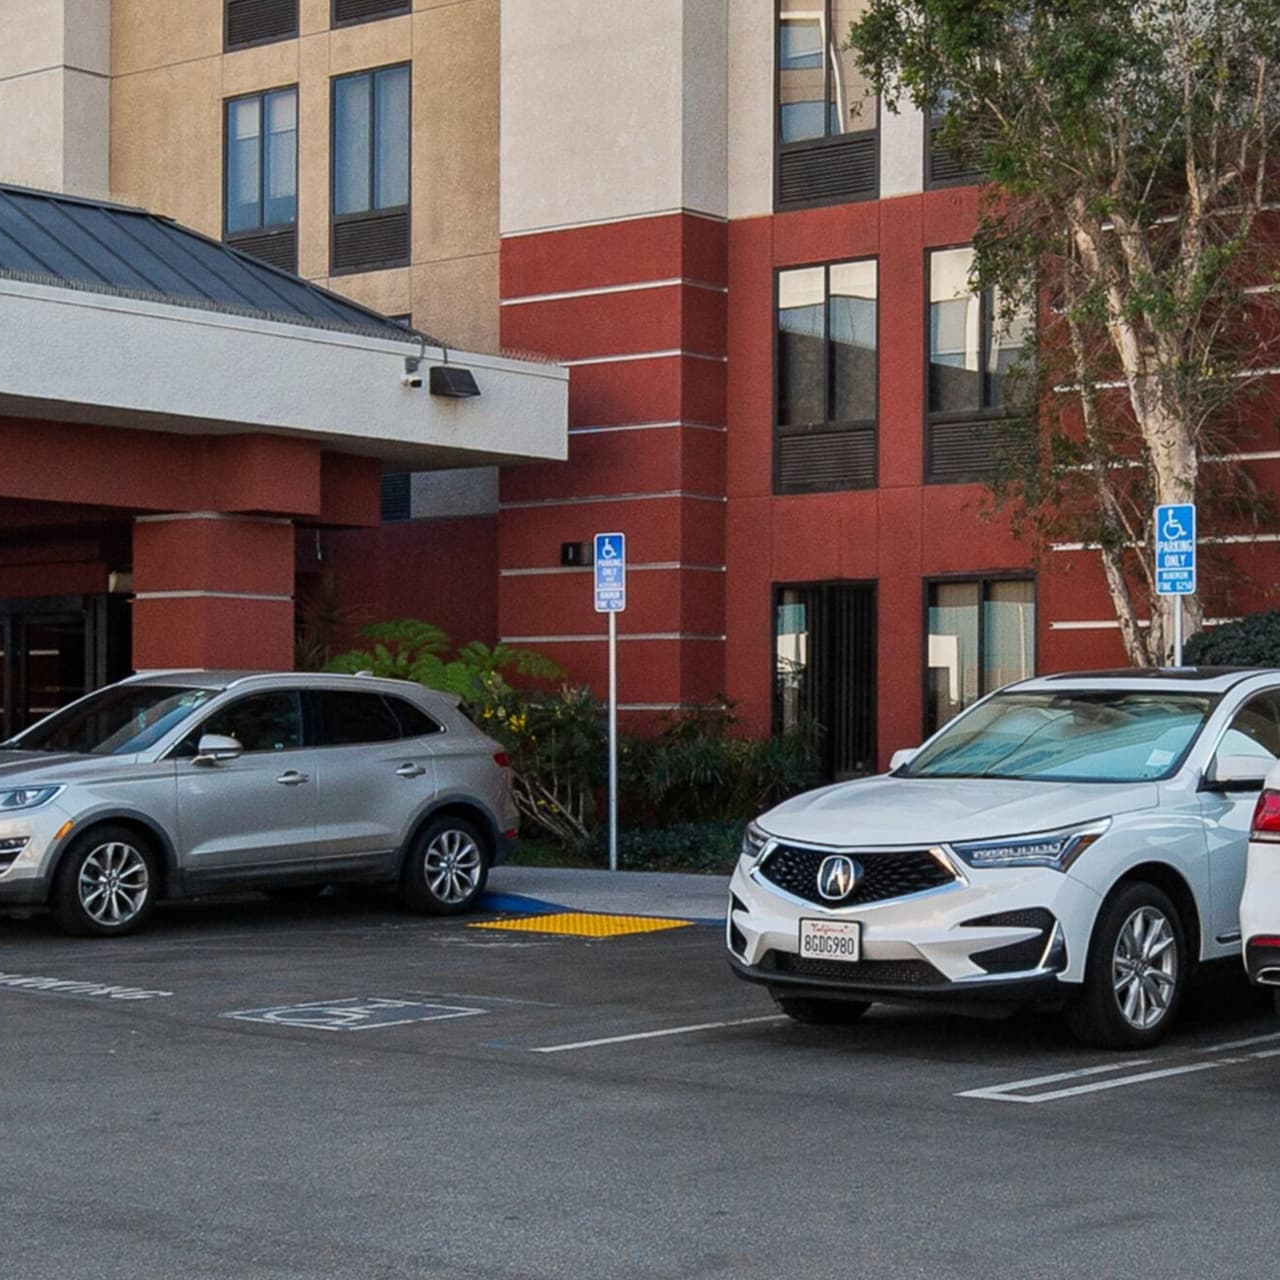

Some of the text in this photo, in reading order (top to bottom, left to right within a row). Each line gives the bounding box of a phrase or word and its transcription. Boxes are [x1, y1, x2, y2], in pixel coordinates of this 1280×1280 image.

[1158, 540, 1193, 553] PARKING
[1164, 554, 1186, 567] ONLY
[804, 934, 855, 955] 8GDG980
